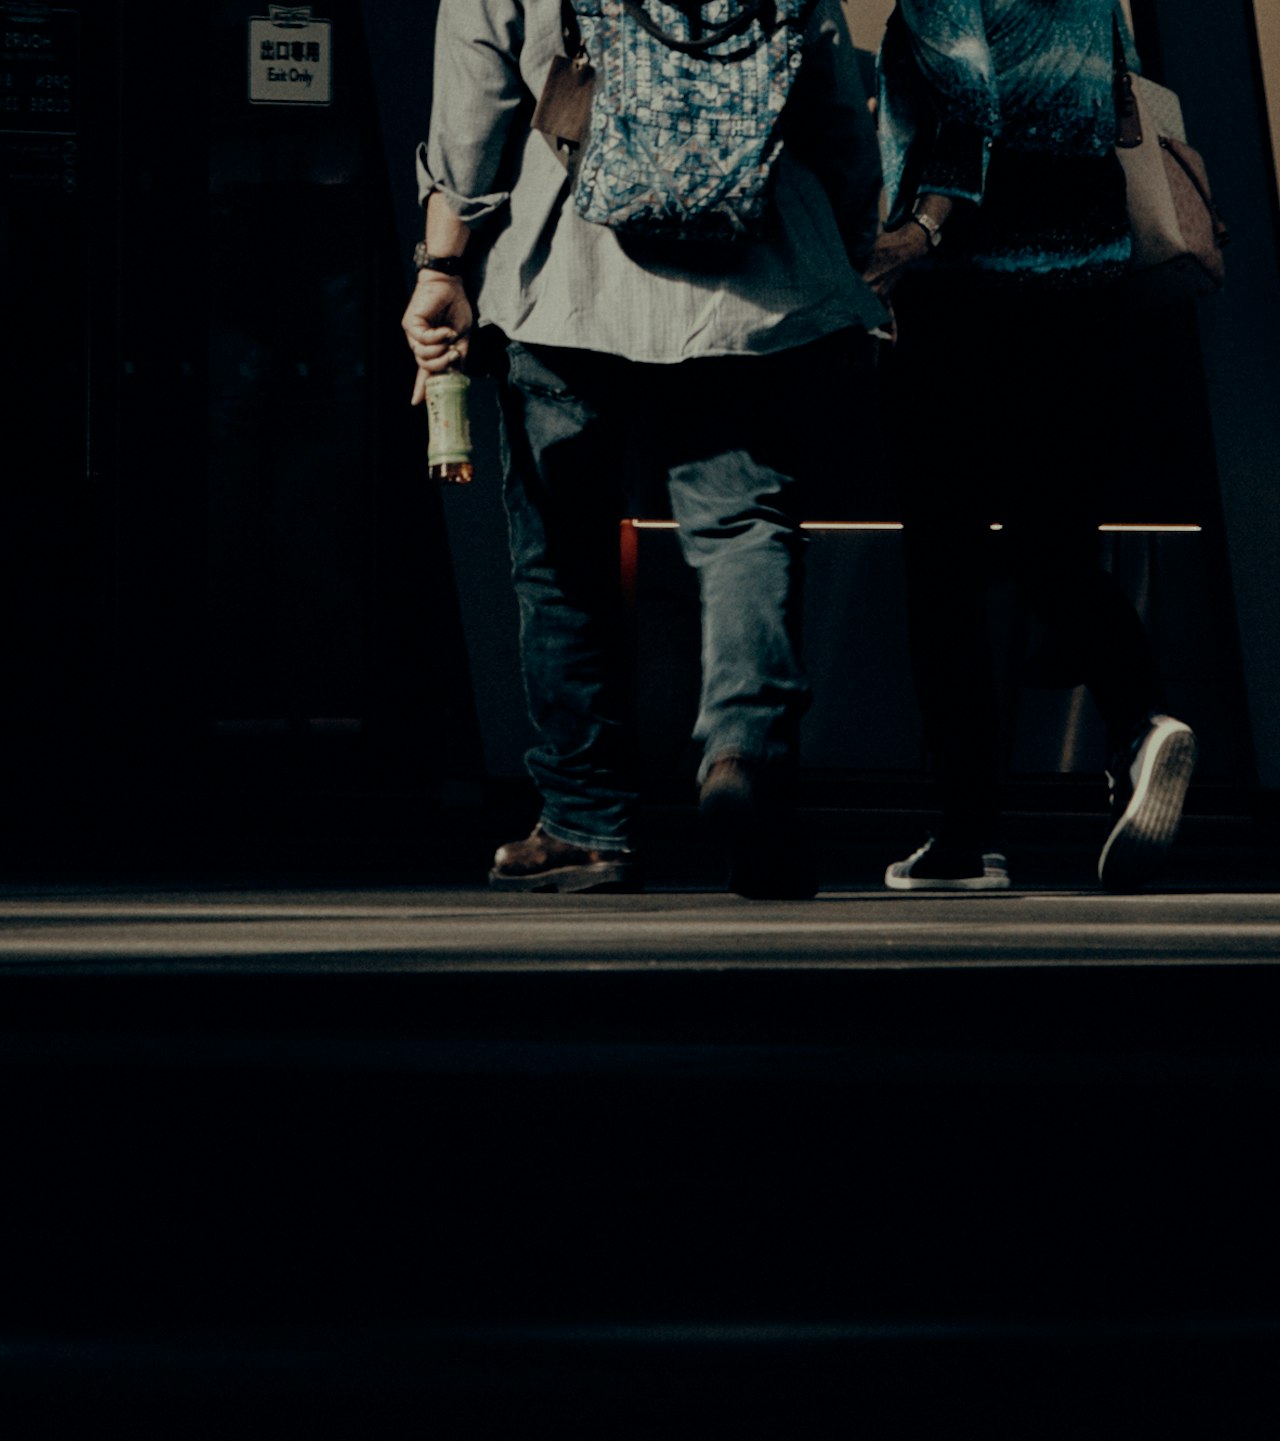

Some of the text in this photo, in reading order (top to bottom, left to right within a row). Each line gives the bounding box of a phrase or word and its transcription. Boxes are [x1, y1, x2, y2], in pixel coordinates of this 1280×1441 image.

[260, 40, 320, 62] 出口専用
[268, 67, 313, 87] Exit Only
